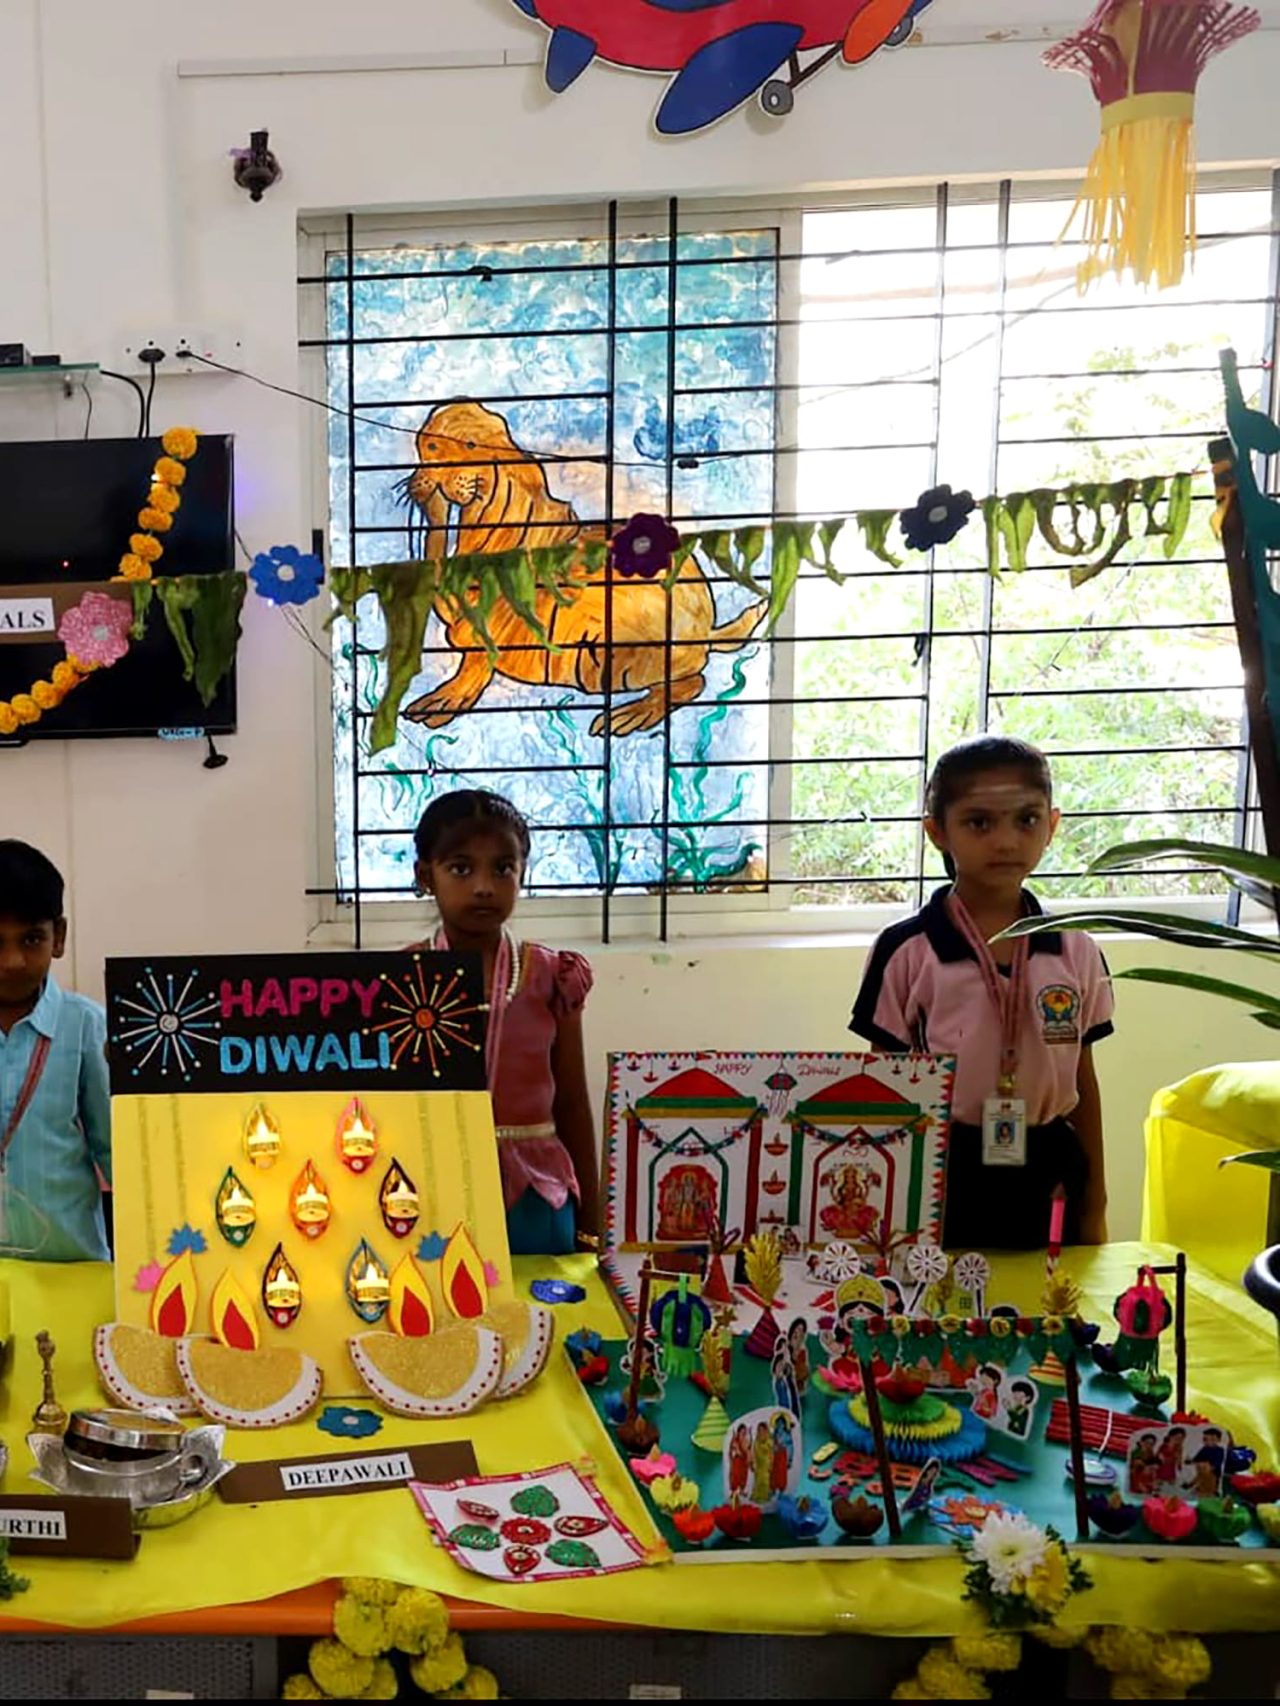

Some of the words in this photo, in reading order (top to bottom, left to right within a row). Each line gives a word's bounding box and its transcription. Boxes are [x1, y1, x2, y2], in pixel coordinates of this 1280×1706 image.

[220, 978, 382, 1018] HAPPY
[220, 1031, 390, 1074] DIWALI
[288, 1461, 408, 1486] DEEPAWALI
